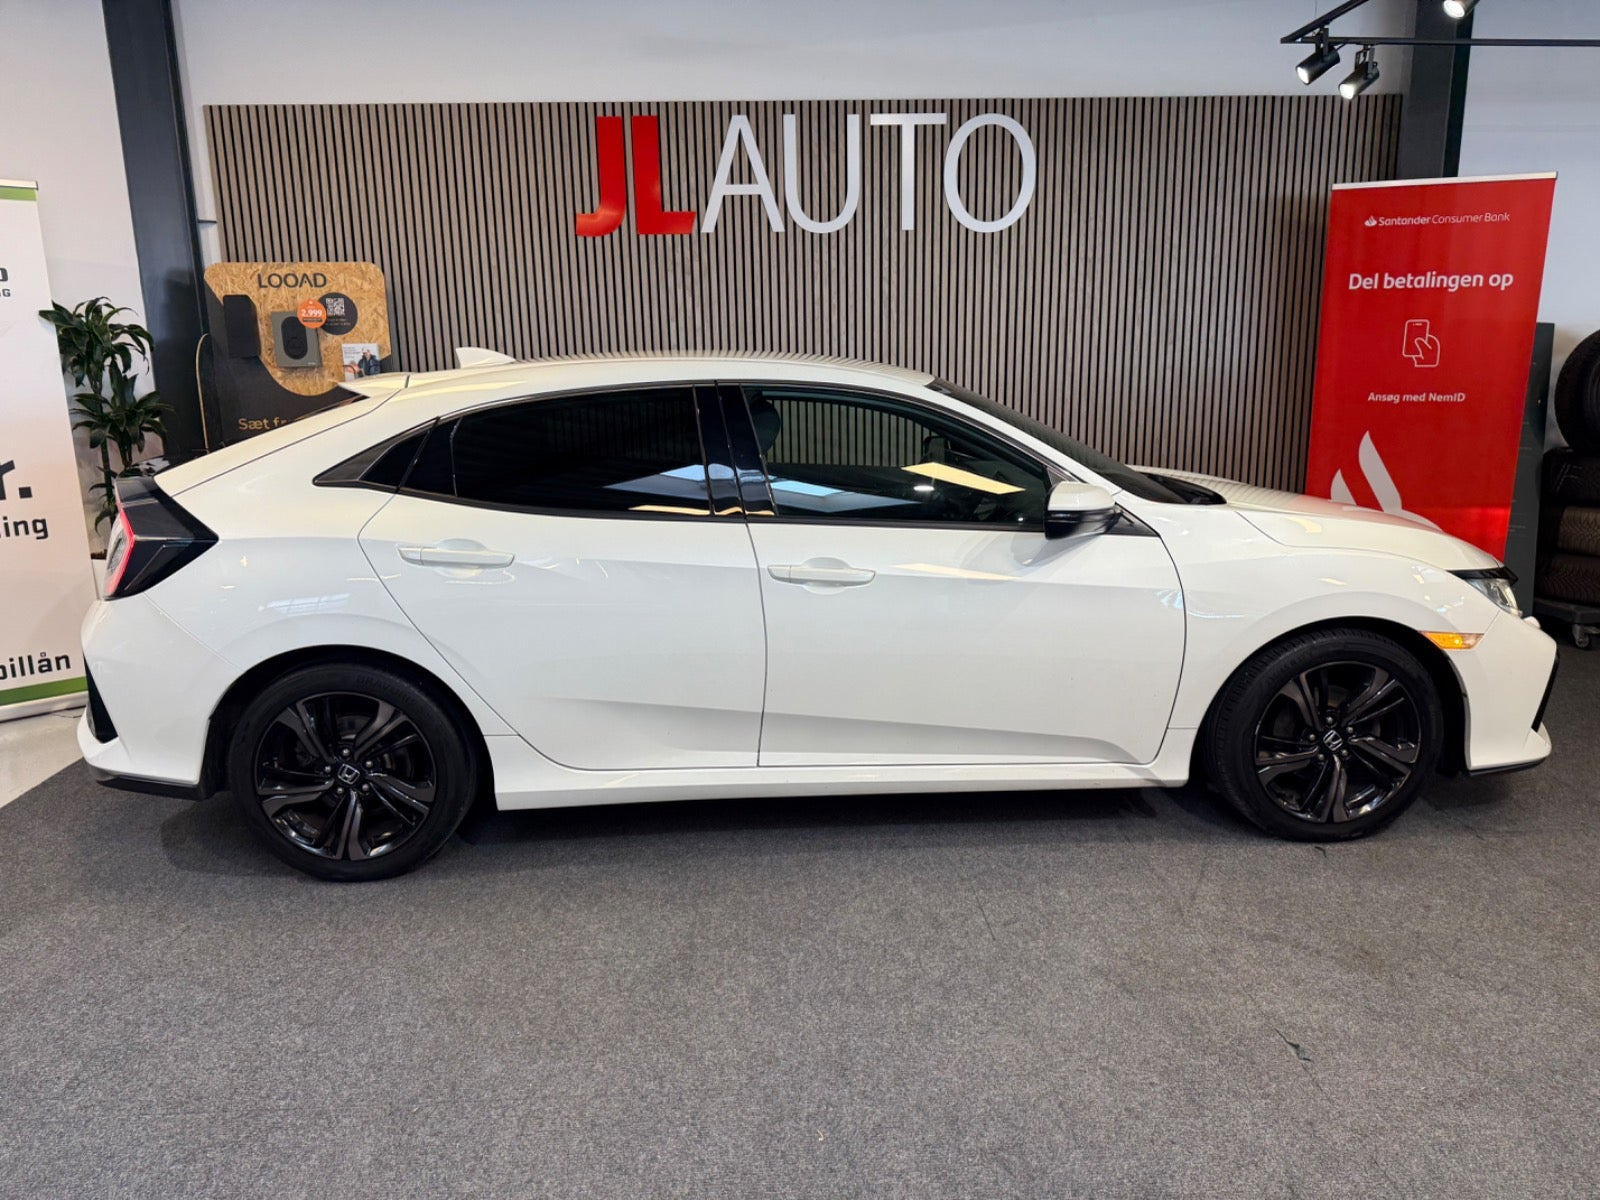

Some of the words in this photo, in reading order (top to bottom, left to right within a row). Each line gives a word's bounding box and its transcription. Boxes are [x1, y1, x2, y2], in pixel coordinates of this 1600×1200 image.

[575, 115, 697, 237] JL
[700, 112, 1037, 234] AUTO
[1378, 214, 1431, 226] Santander
[1431, 212, 1483, 224] Consumer
[1484, 211, 1511, 222] Bank
[257, 272, 327, 288] LOOAD
[1348, 273, 1379, 290] Del
[1383, 271, 1484, 292] betalingen
[1488, 273, 1514, 291] op
[1368, 392, 1400, 404] Ansøg
[1402, 392, 1426, 402] med
[1428, 392, 1466, 402] NemID
[238, 417, 270, 430] Sæt
[0, 515, 49, 540] ing
